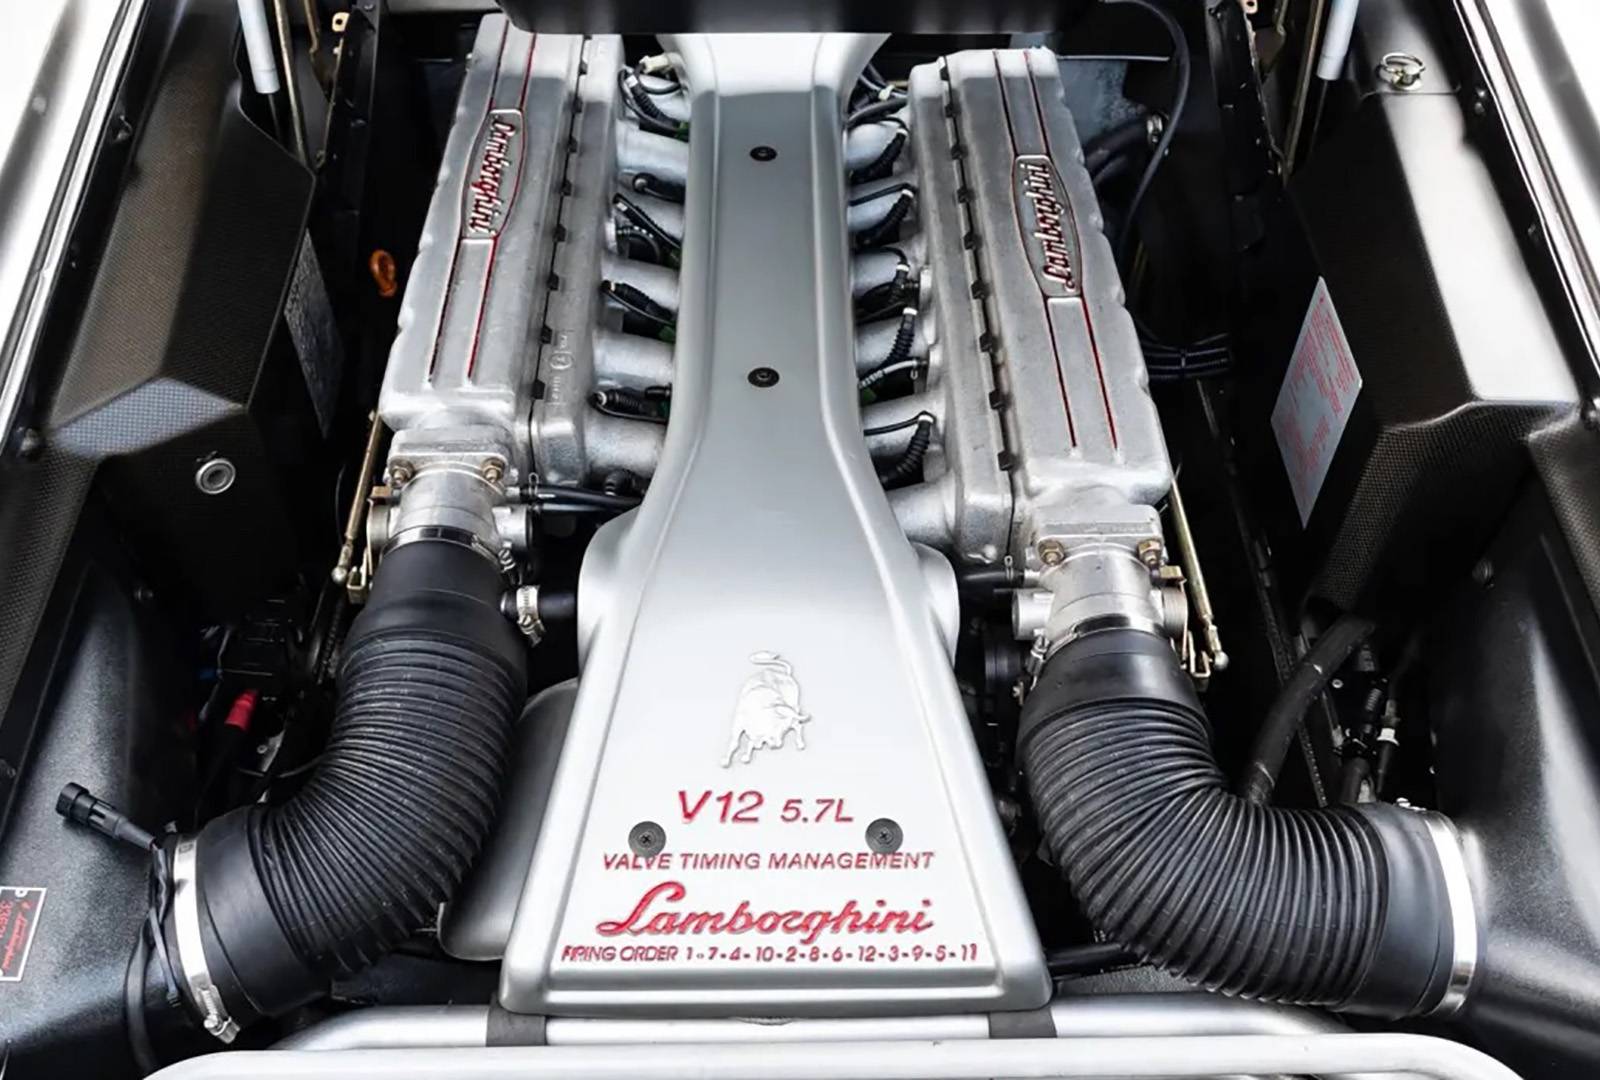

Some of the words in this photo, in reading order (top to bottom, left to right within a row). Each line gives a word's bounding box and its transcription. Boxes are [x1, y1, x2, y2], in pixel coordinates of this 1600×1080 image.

[470, 115, 516, 237] Lamborghini
[1019, 162, 1076, 292] Lamborghini
[678, 790, 764, 824] V12
[780, 798, 854, 822] 5.7L
[603, 852, 673, 870] VALVE
[680, 852, 761, 870] TIMING
[768, 851, 934, 870] MANAGEMENT
[595, 880, 934, 945] Lamborghini
[619, 945, 679, 962] ORDER
